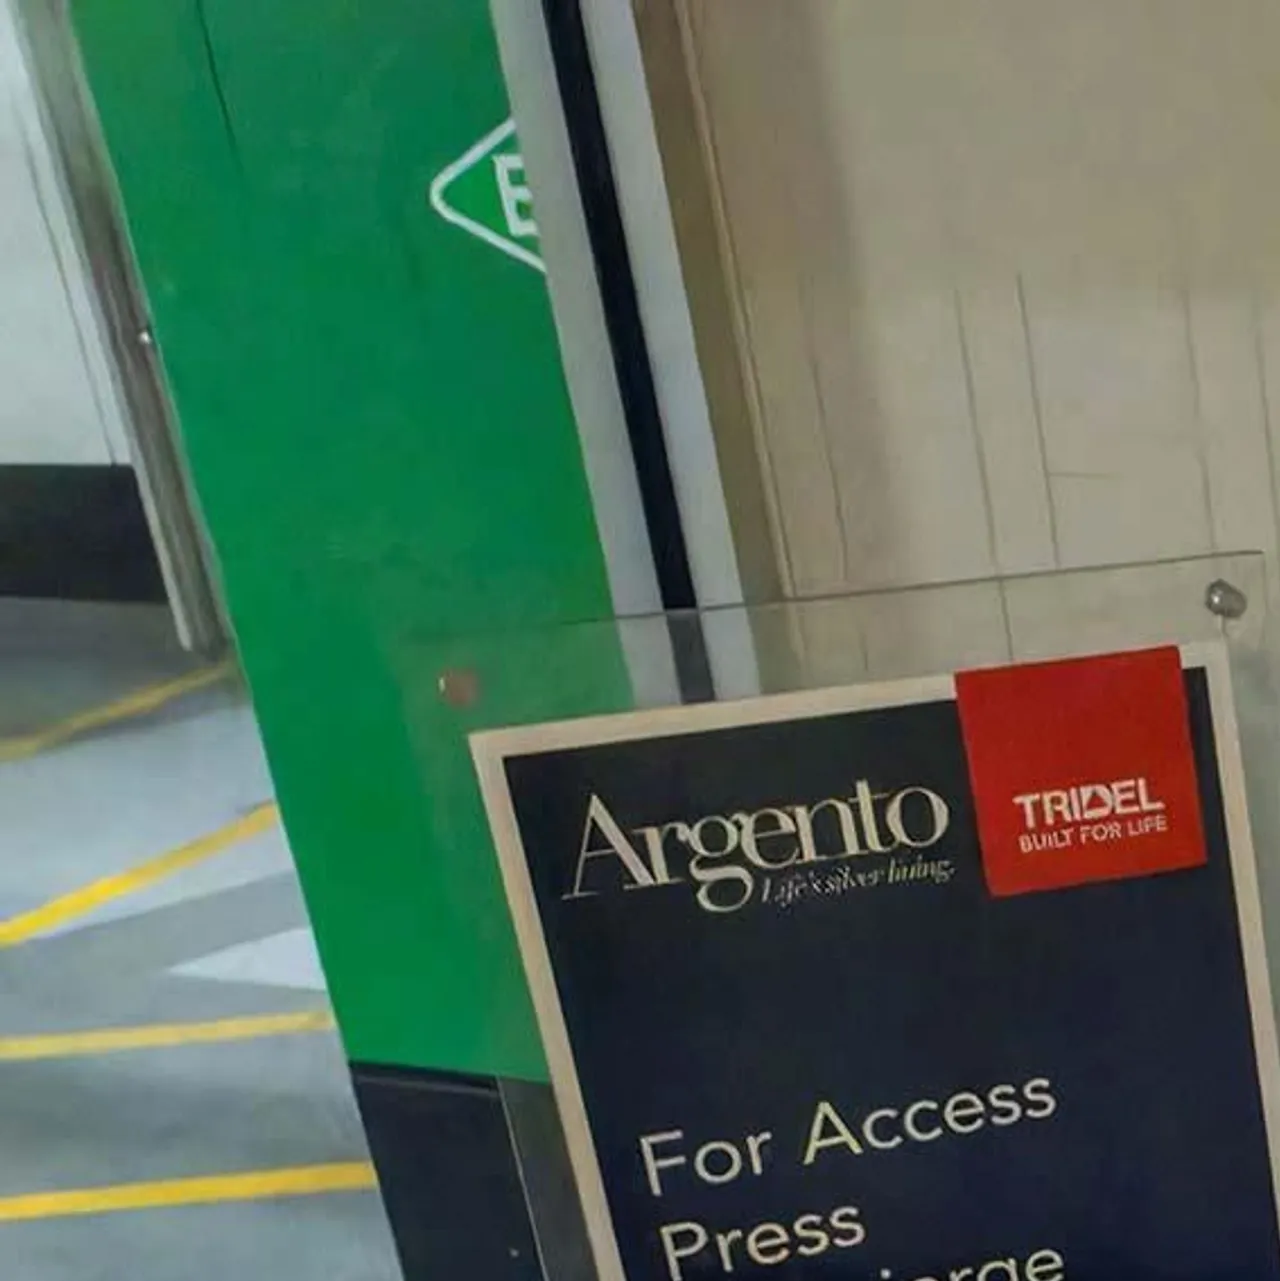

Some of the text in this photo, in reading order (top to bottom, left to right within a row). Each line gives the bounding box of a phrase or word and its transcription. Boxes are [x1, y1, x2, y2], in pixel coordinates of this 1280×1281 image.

[562, 778, 950, 913] Argento
[1012, 777, 1165, 829] TRIDEL
[1018, 814, 1168, 853] BUILT FOR LIFE
[639, 1076, 1057, 1196] For Access
